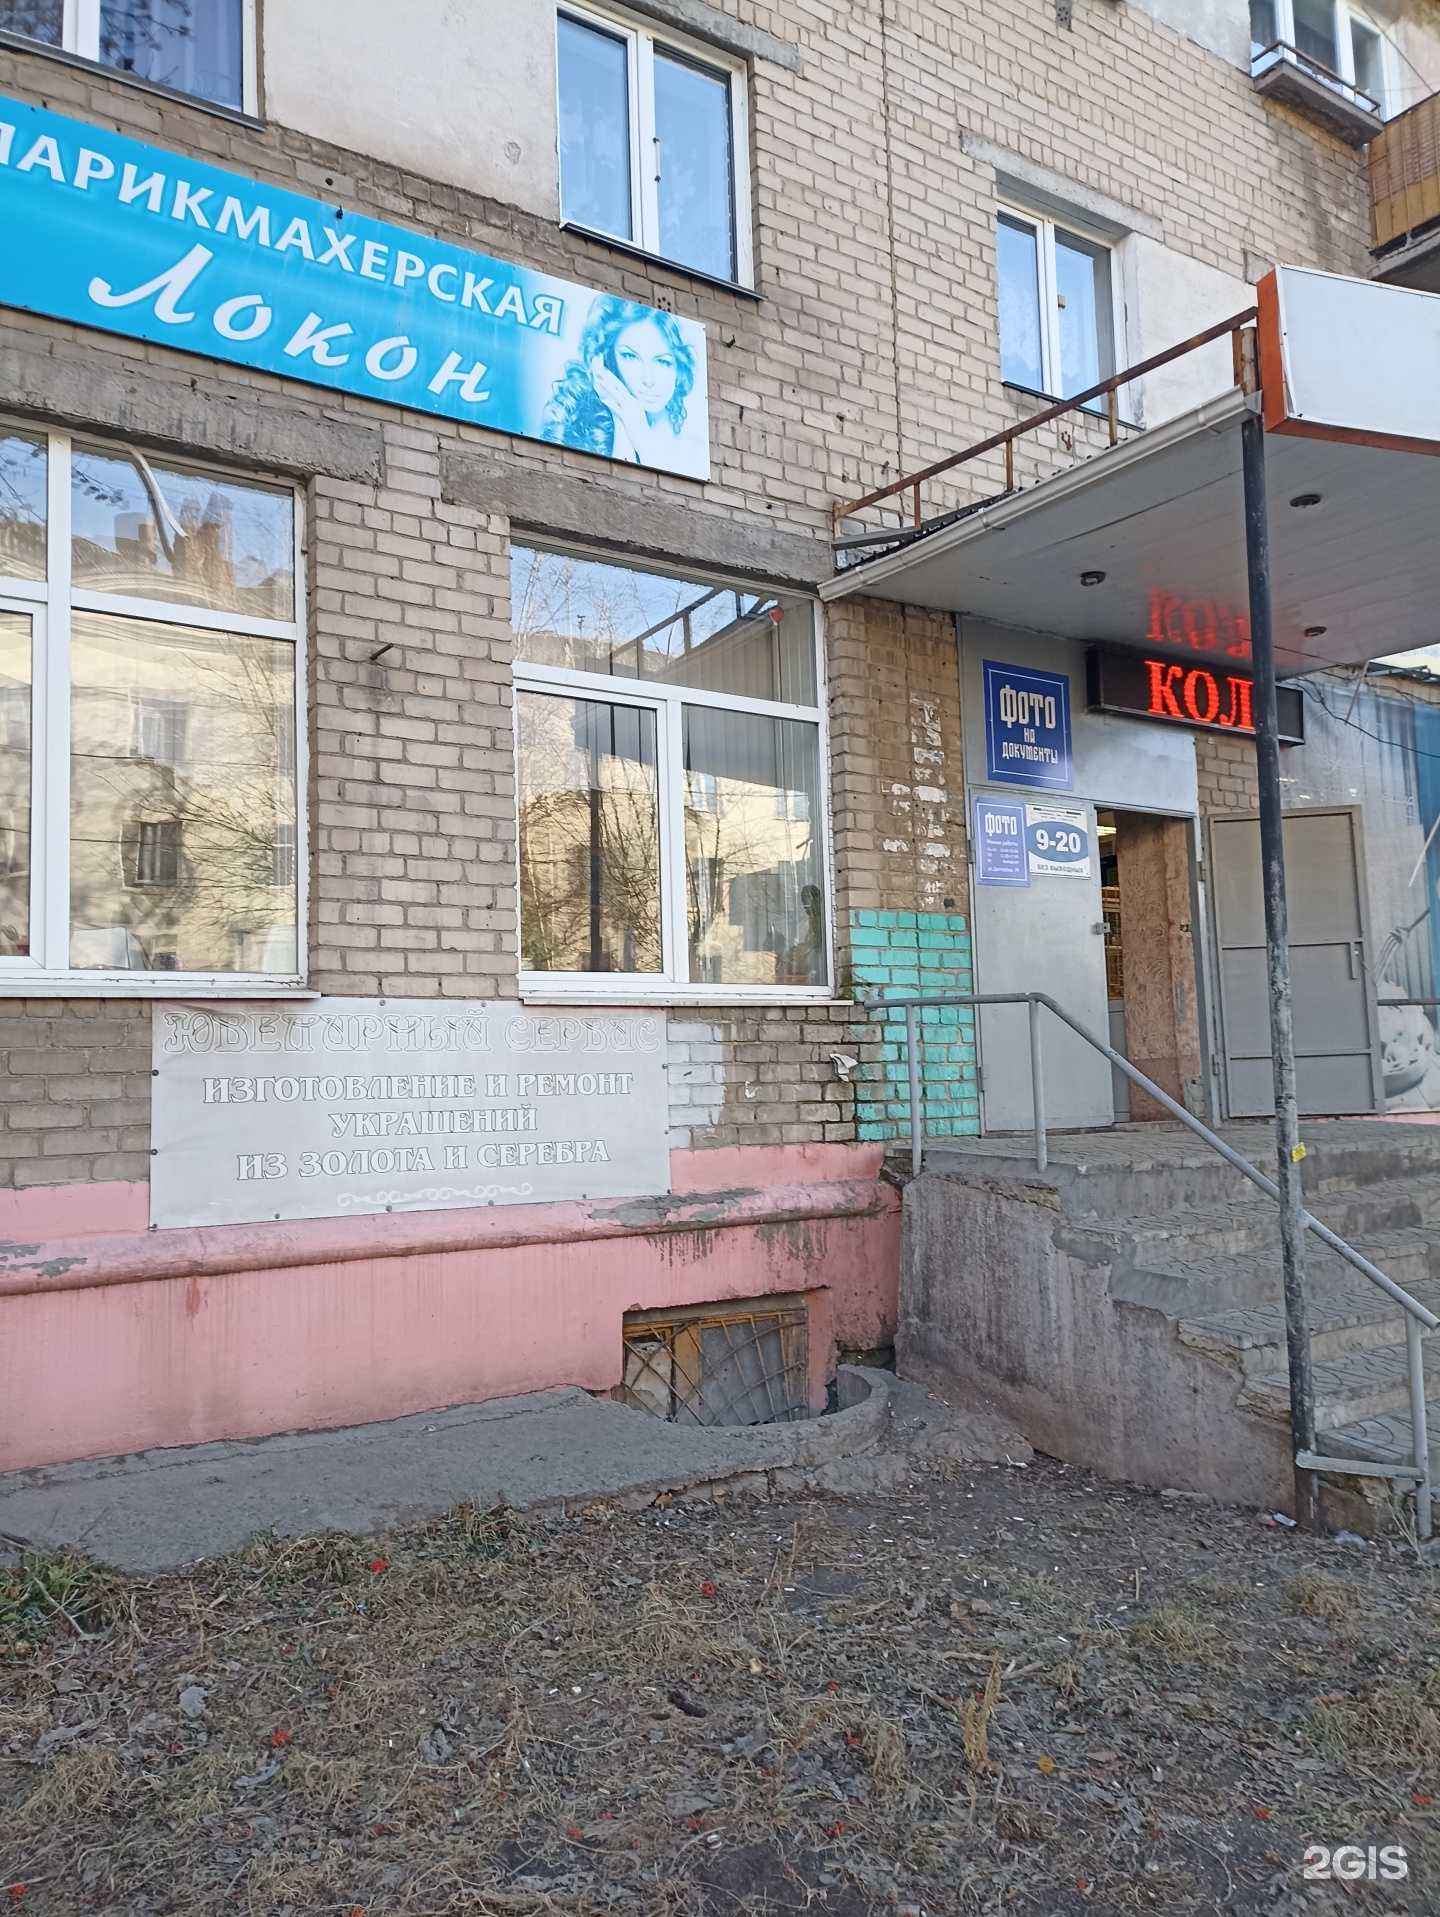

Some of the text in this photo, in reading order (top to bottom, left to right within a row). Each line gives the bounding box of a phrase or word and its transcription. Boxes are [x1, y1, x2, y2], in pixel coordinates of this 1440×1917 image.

[88, 243, 490, 403] Локон
[1000, 684, 1056, 729] ФОТО
[1144, 660, 1255, 730] КОЛ
[1002, 741, 1059, 764] ДОКУМЕНТЫ
[984, 812, 1018, 837] ФОТО
[1036, 829, 1081, 853] 9-20
[164, 1008, 660, 1052] ЮВЕЛИРНЫЙ СЕРВИС
[202, 1072, 634, 1104] ИЗГОТОВЛЕНИЕ И РЕМОНТ
[328, 1104, 538, 1138] УКРАШЕНИЙ
[236, 1140, 612, 1181] ИЗ ЗОЛОТА И СЕРЕБРА
